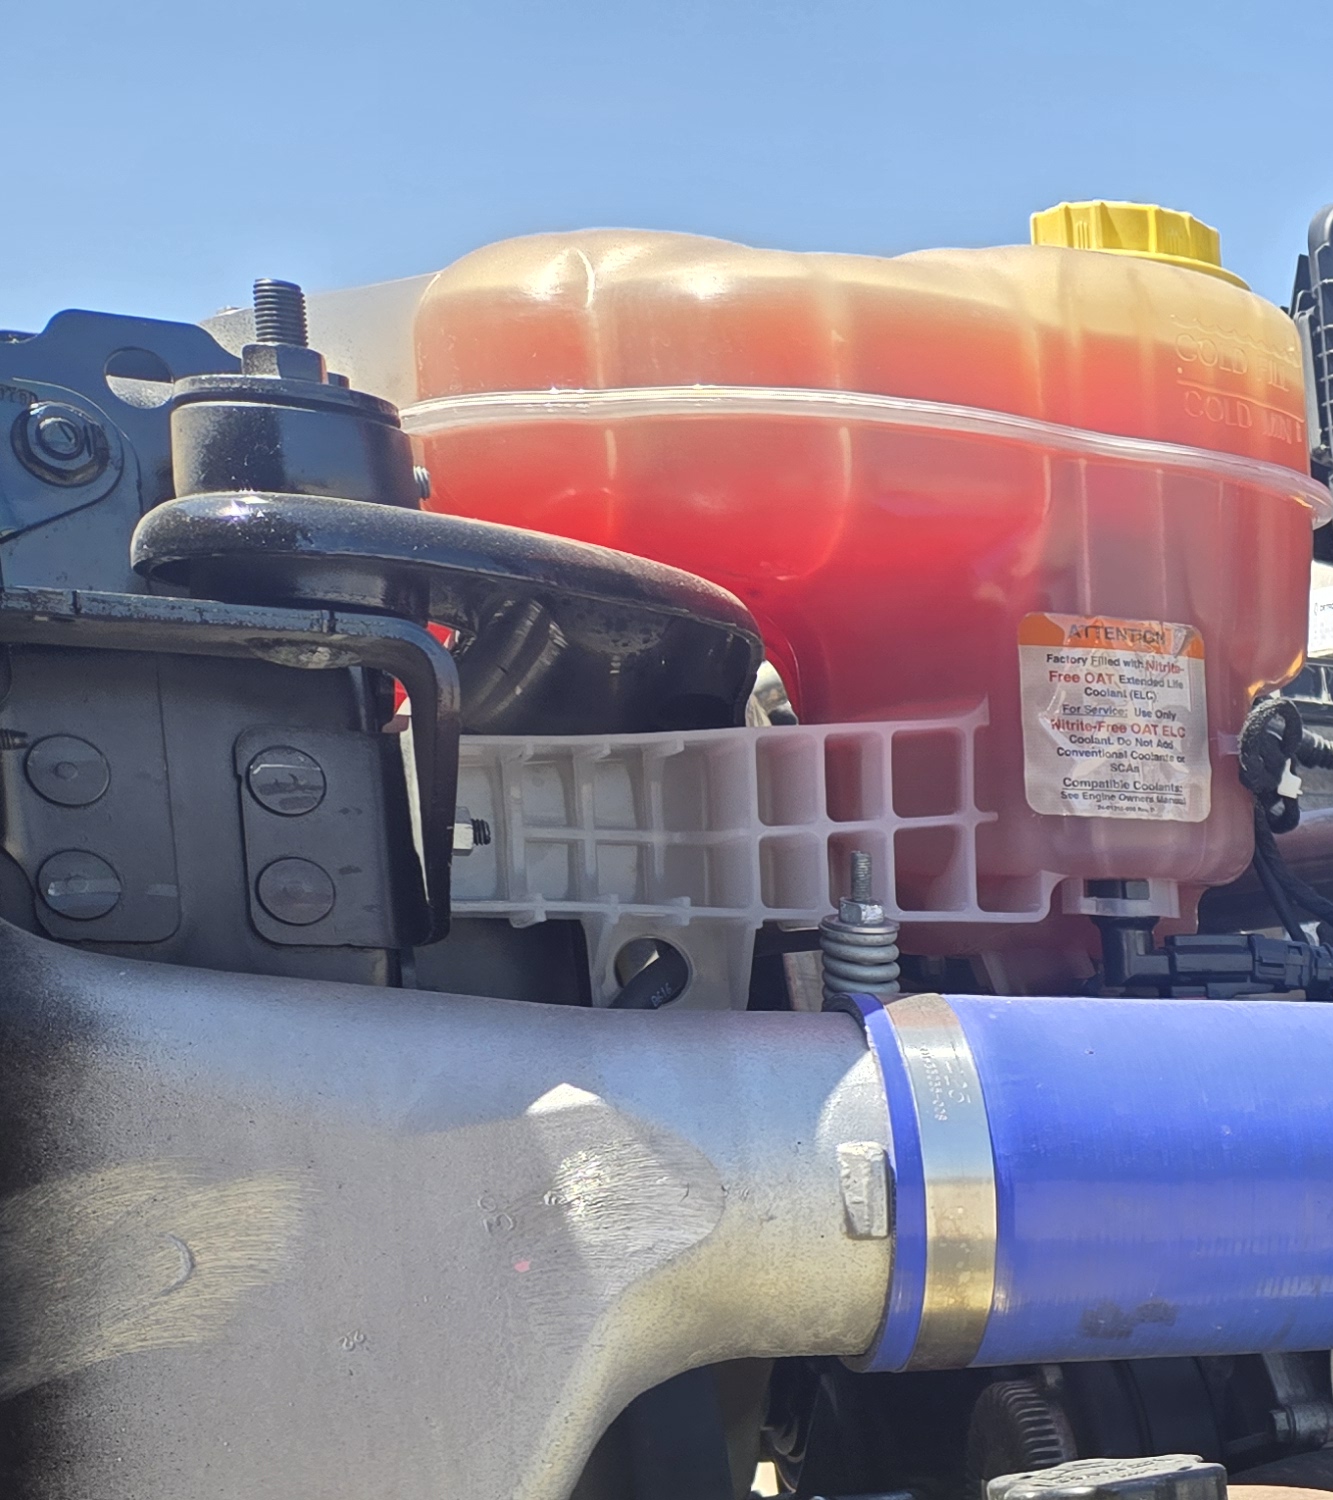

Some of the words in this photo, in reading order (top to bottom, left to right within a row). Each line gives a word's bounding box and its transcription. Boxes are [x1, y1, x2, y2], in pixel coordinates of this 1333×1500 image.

[1176, 333, 1248, 374] COLD
[1184, 390, 1253, 428] COLD
[1068, 623, 1165, 646] ATTENTION
[1046, 653, 1088, 667] Factory
[1091, 655, 1120, 668] Filled
[1123, 658, 1143, 669] with
[1145, 660, 1184, 674] Nitrite-
[1049, 670, 1081, 683] Free
[1084, 672, 1115, 685] OAT
[1119, 675, 1165, 688] Extended
[1167, 678, 1184, 689] Life
[1084, 686, 1127, 699] Coolant
[1129, 689, 1157, 701] (ELC)
[1062, 703, 1081, 715] For
[1084, 705, 1128, 717] Service:
[1134, 707, 1152, 718] Use
[1156, 709, 1177, 721] Only
[1050, 718, 1127, 734] Nitrite-Free
[1131, 722, 1158, 736] OAT
[1162, 726, 1186, 738] ELC
[1117, 736, 1132, 747] Do
[1135, 738, 1153, 748] Not
[1056, 746, 1127, 760] Conventional
[1062, 777, 1130, 791] Compatible
[1133, 780, 1183, 793] Coolants:
[1060, 791, 1079, 800] See
[1082, 792, 1116, 803] Engine
